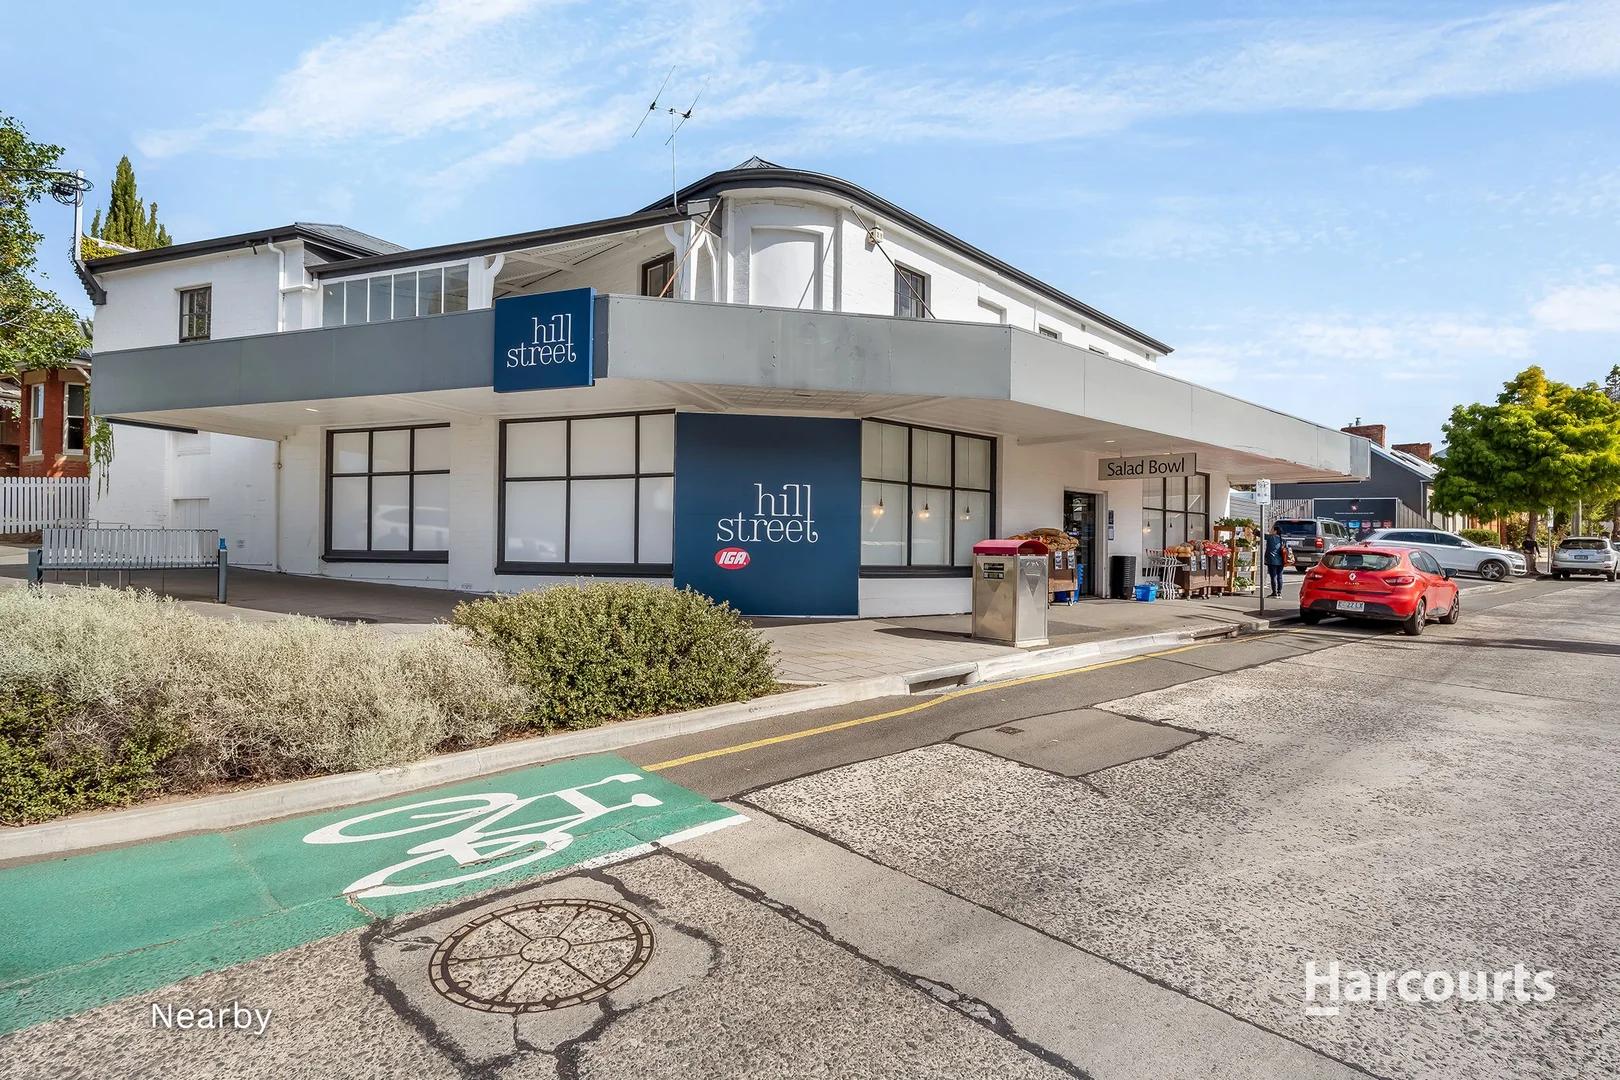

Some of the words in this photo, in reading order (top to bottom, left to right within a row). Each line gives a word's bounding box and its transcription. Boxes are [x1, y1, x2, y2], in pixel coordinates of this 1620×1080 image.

[531, 313, 572, 345] hill
[506, 342, 577, 368] street
[1107, 460, 1144, 477] Salad
[1149, 457, 1185, 475] Bowl
[753, 483, 812, 517] hill
[716, 511, 819, 544] street
[718, 551, 747, 565] IGA
